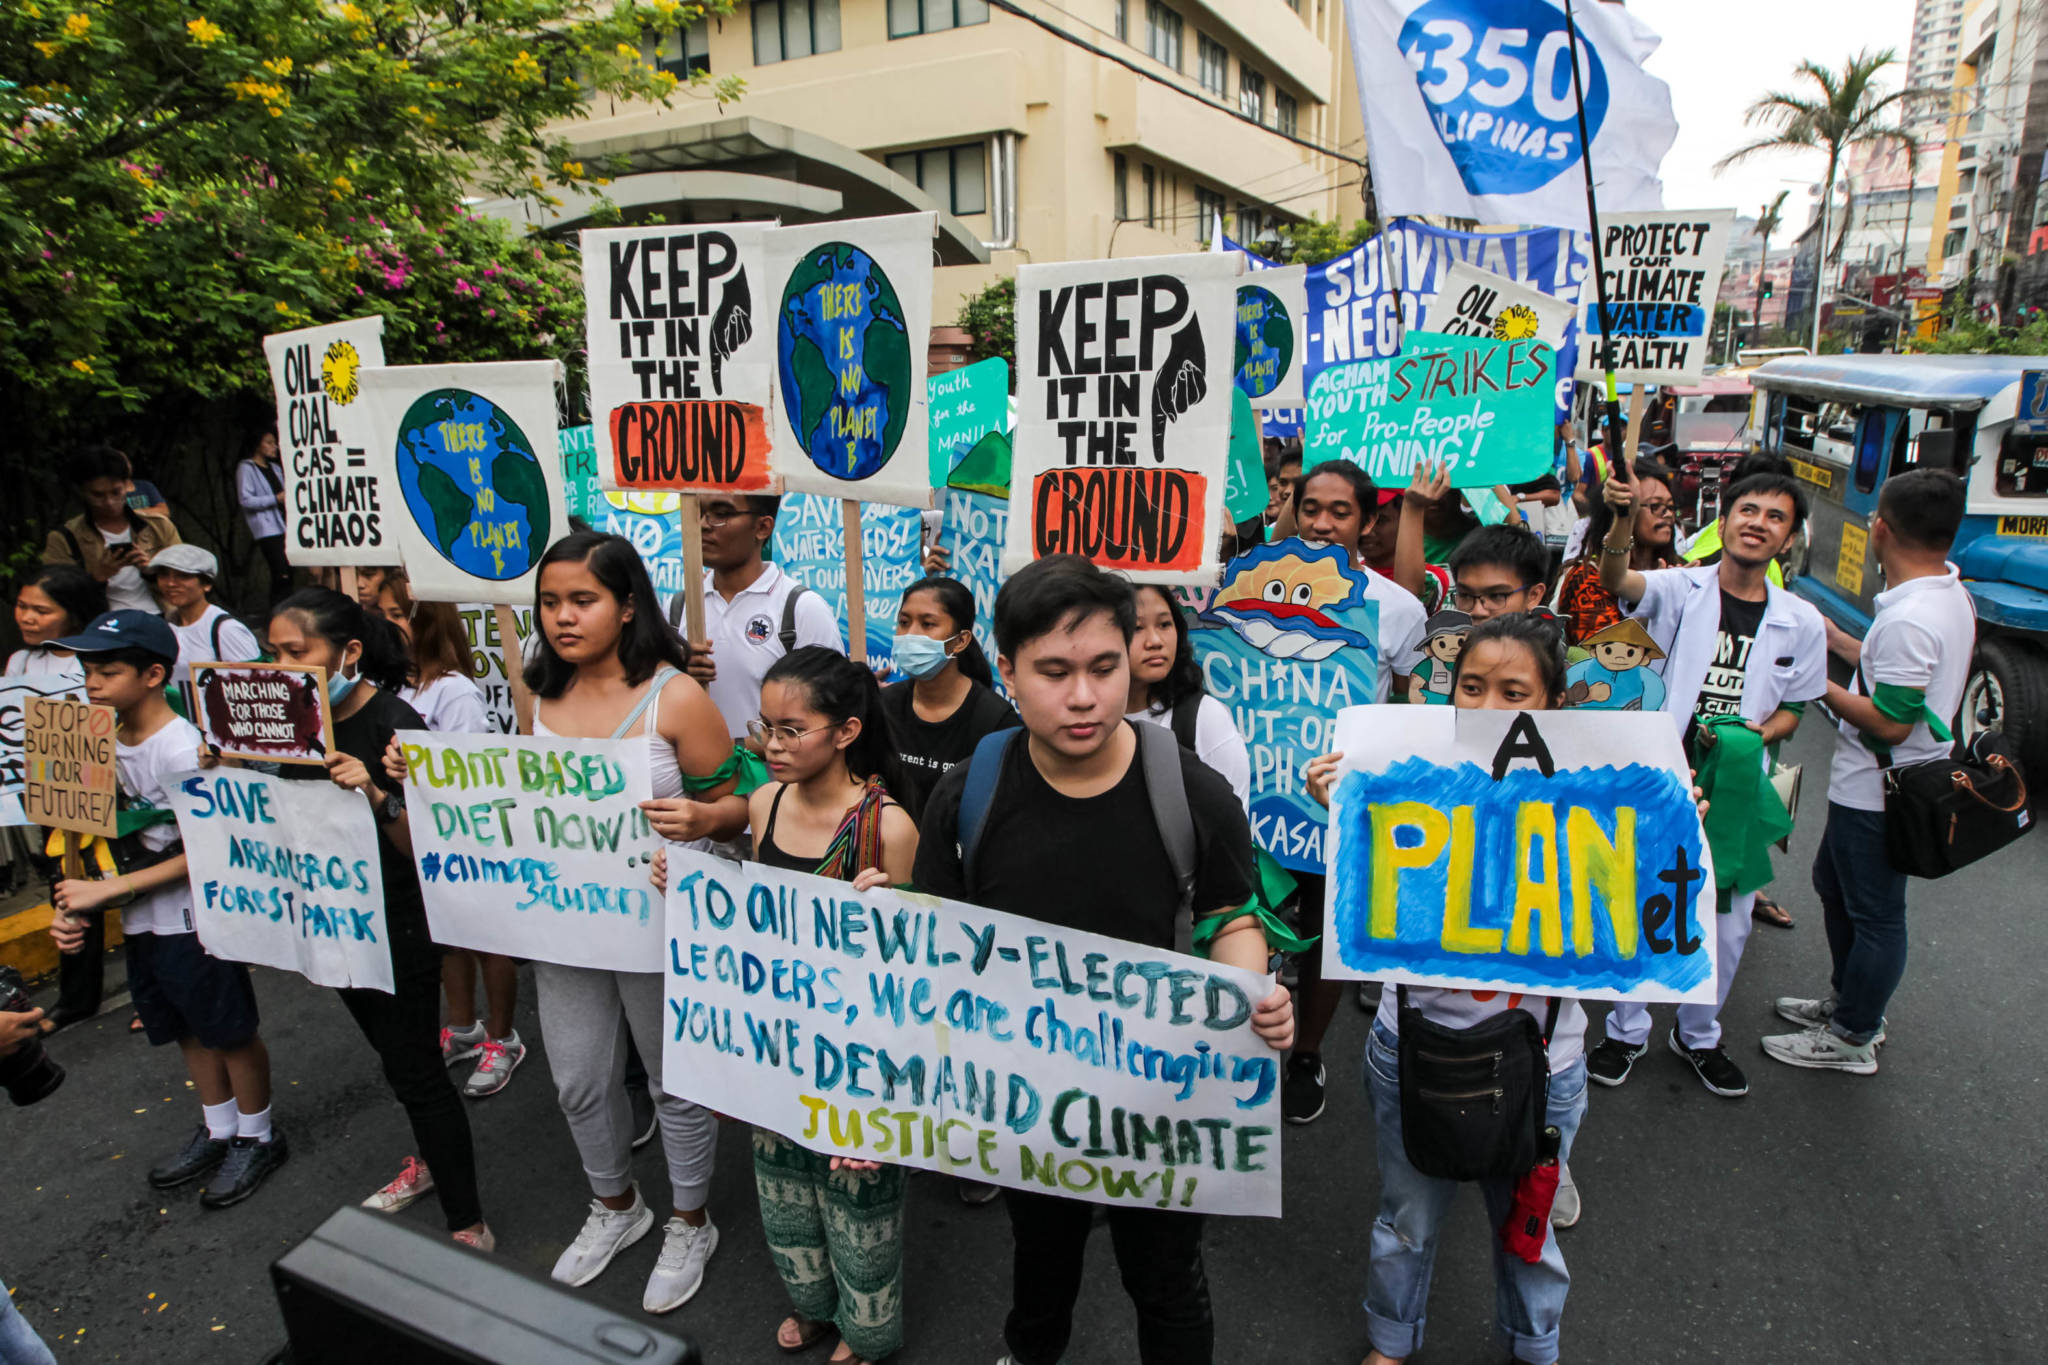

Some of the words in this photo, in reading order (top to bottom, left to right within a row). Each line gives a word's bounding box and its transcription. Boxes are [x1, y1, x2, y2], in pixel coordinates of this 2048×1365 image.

[1408, 18, 1591, 121] 350
[1604, 222, 1711, 259] PROTECT
[608, 230, 738, 320] KEEP
[1629, 255, 1672, 268] OUR
[818, 281, 863, 322] THERE
[1598, 302, 1693, 333] WATER
[619, 320, 655, 359] IT
[664, 318, 701, 358] IN
[839, 325, 855, 361] IS
[1037, 273, 1190, 377] KEEP
[1616, 331, 1661, 341] AND
[1389, 341, 1550, 403] STRIKES
[1589, 340, 1690, 371] HEALTH
[632, 360, 701, 400] THE
[841, 363, 862, 399] NO
[1046, 376, 1088, 421] IT
[1097, 373, 1141, 419] IN
[1310, 360, 1391, 398] AGHAM
[955, 399, 977, 417] the
[1308, 382, 1389, 422] YOUTH
[437, 421, 488, 453] THERE
[829, 405, 879, 442] PLANET
[1310, 421, 1349, 448] for
[1361, 399, 1497, 442] Pro-People
[293, 446, 336, 478] GAS
[618, 402, 747, 484] GROUND
[845, 440, 858, 475] B
[1057, 420, 1138, 466] THE
[467, 456, 484, 486] IS
[295, 475, 381, 515] CLIMATE
[476, 487, 495, 515] NO
[297, 512, 382, 549] CHAOS
[468, 519, 523, 550] PLANET
[1035, 470, 1190, 565] GROUND
[490, 548, 506, 578] B
[219, 681, 291, 702] MARCHING
[1202, 651, 1353, 710] CHINA
[31, 700, 90, 733] STOP
[227, 702, 251, 721] FOR
[250, 702, 287, 721] THOSE
[25, 728, 110, 765] BURNING
[228, 722, 255, 739] WHO
[254, 722, 296, 740] CANNOT
[1490, 711, 1557, 782] A
[52, 759, 84, 785] OUR
[28, 781, 115, 828] FUTURE!
[431, 797, 518, 848] DIET
[301, 901, 378, 944] PARK
[678, 869, 738, 932] TO
[812, 896, 1255, 1034] NEWLY-ELECTED
[943, 988, 1015, 1044] are
[748, 1010, 806, 1078] WE
[811, 1032, 1042, 1136] DEMAND
[1050, 1086, 1275, 1174] CLIMATE
[798, 1093, 1001, 1178] JUSTICE
